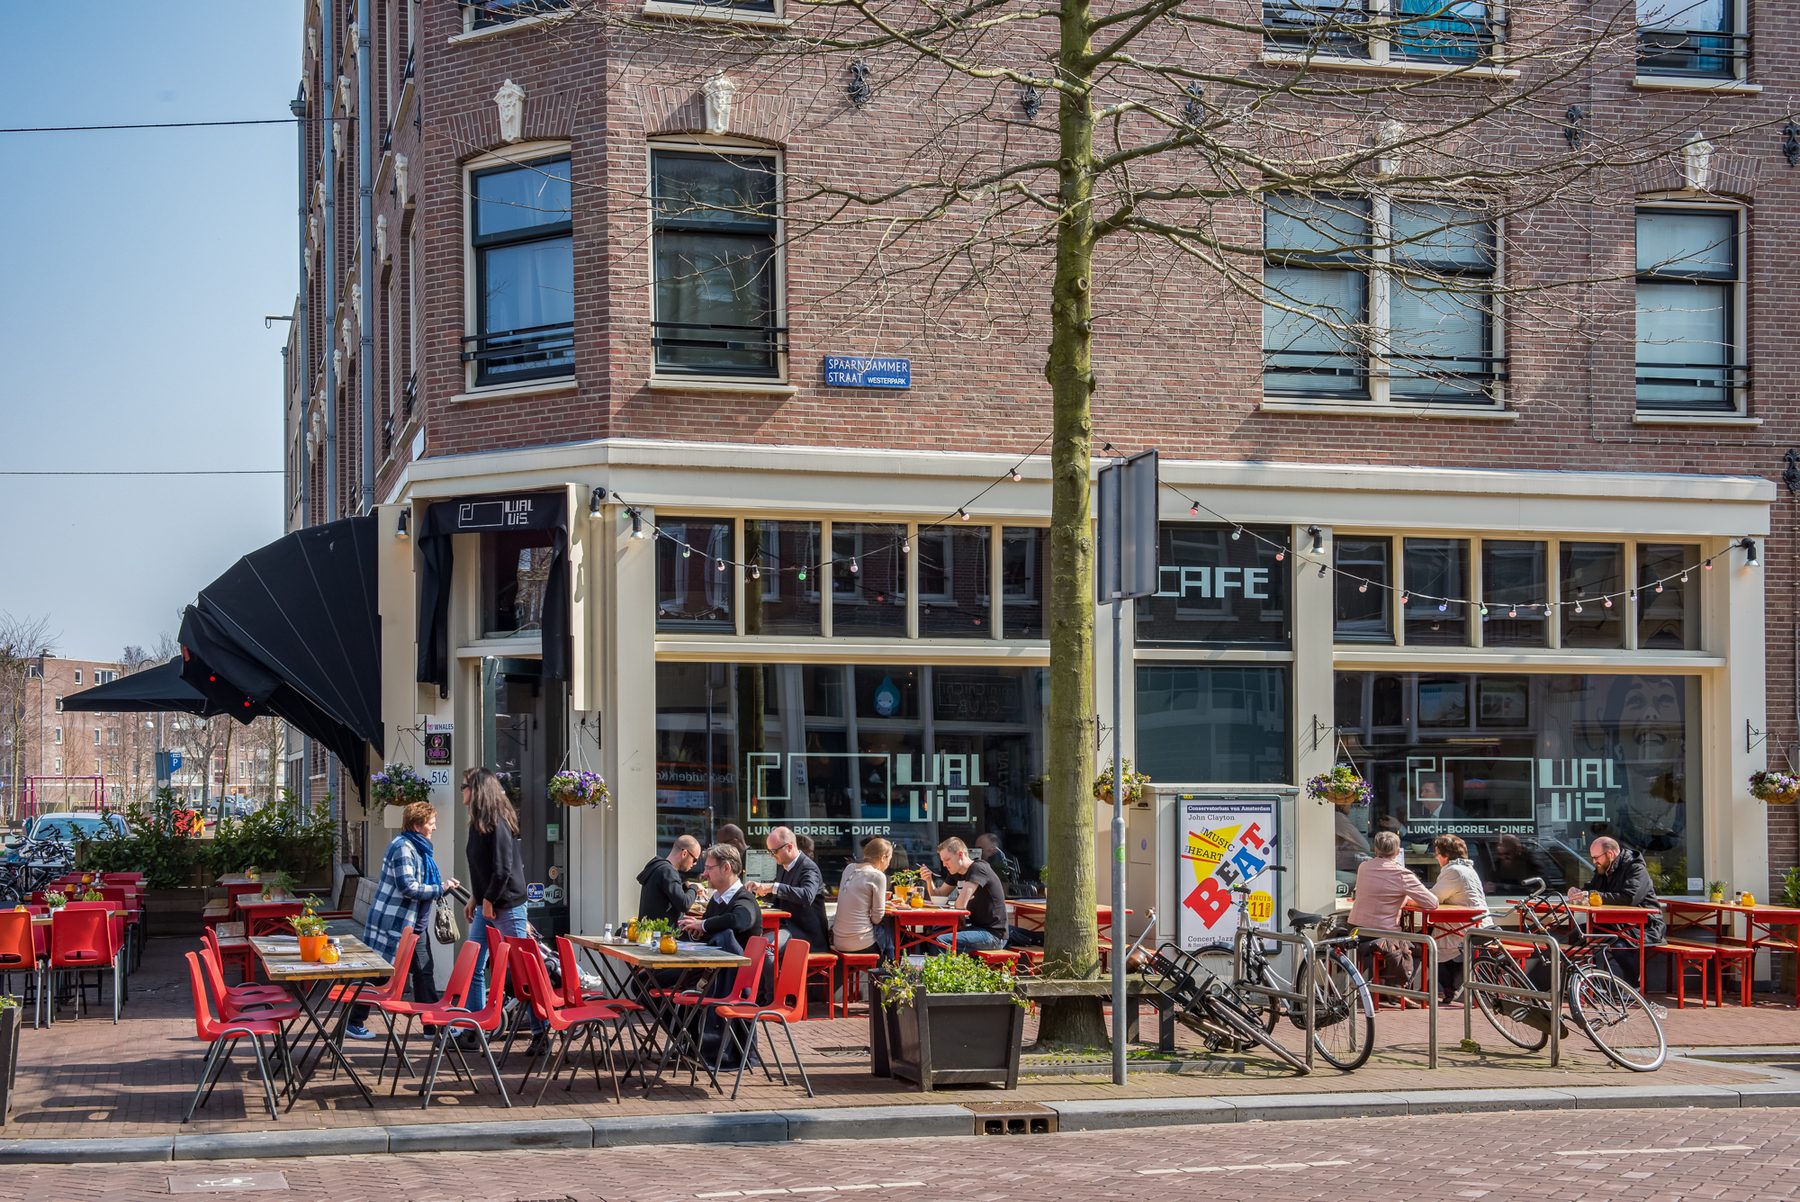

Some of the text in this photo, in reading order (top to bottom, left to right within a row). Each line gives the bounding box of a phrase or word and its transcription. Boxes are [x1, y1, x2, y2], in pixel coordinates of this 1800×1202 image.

[828, 359, 908, 373] SPAARNDAMMER
[828, 372, 863, 383] STRAAT
[1152, 566, 1268, 598] CAFE
[173, 758, 179, 766] P
[896, 753, 990, 786] WAL
[432, 772, 448, 783] 516
[1538, 758, 1622, 788] WAL
[1202, 828, 1235, 852] MUSIC
[1188, 846, 1224, 861] HEART
[1251, 902, 1264, 917] 11
